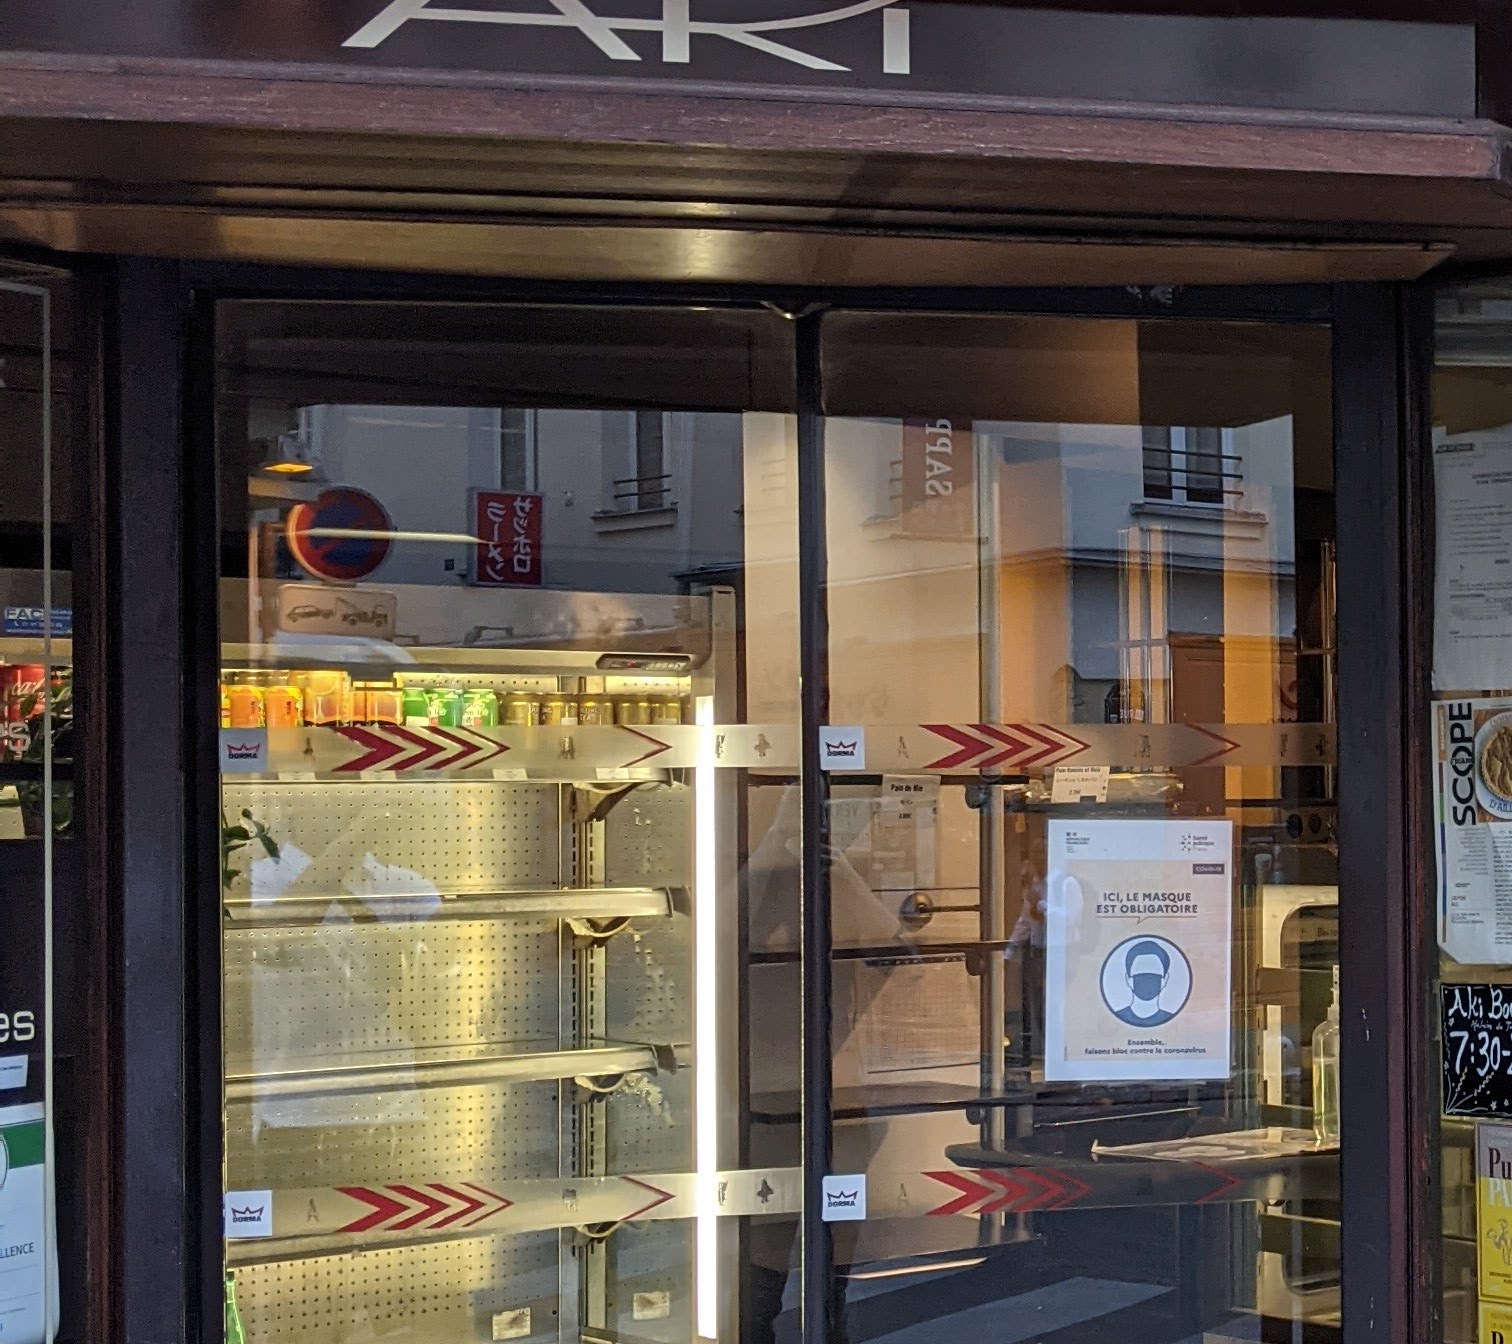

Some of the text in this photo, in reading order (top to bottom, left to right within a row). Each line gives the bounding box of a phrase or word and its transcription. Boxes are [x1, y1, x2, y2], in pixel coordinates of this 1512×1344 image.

[1448, 702, 1477, 826] SCOPE
[1097, 904, 1198, 913] EST OBLIGATOIRE
[1103, 892, 1191, 903] ICI, LE MASQUE
[1448, 986, 1484, 1020] Aki
